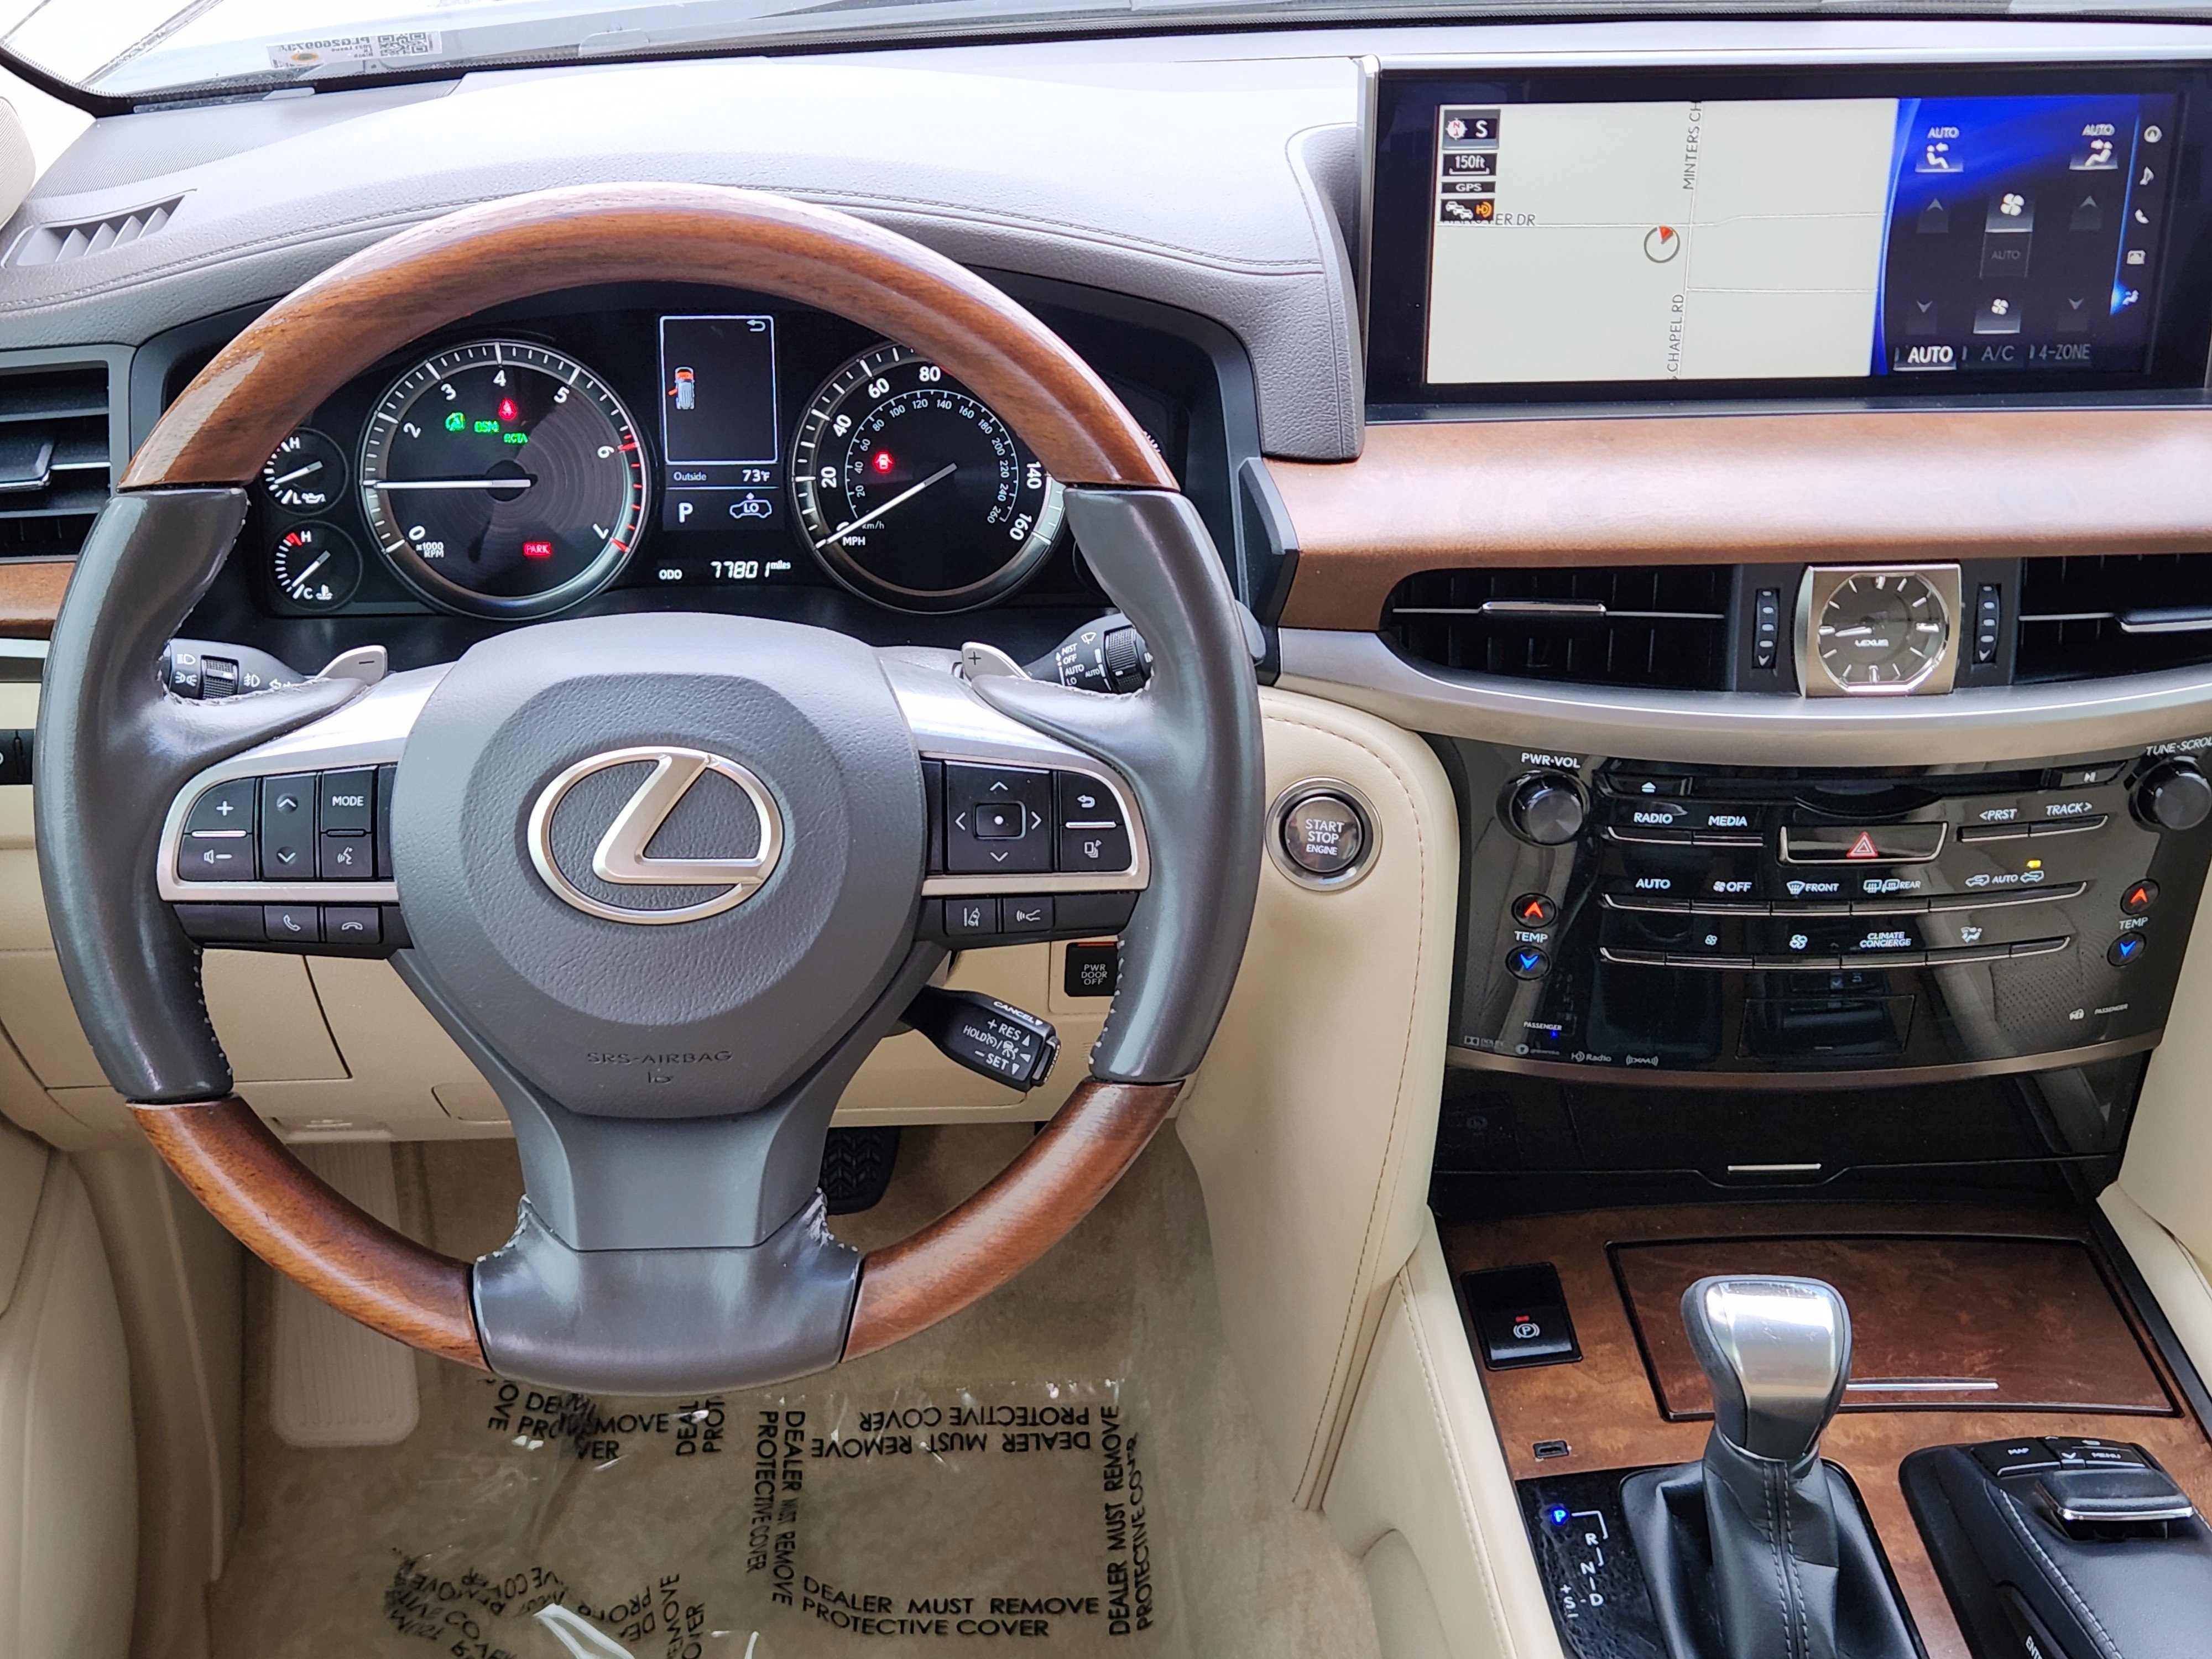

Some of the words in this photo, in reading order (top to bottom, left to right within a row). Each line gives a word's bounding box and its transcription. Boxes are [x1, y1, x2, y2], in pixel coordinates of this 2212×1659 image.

[1475, 119, 1488, 138] S
[1928, 126, 1959, 139] AUTO
[2081, 123, 2116, 137] AUTO
[1455, 155, 1485, 169] 150ft
[1683, 126, 1699, 190] MINTERS
[1455, 183, 1482, 192] GPS
[1516, 213, 1536, 226] DR
[1991, 249, 2021, 260] AUTO
[1672, 294, 1684, 312] RD
[1667, 317, 1682, 372] CHAPEL
[2039, 343, 2091, 360] 4-ZONE
[1907, 346, 1954, 364] AUTO
[1981, 346, 2016, 361] A/C
[493, 371, 507, 387] 4
[919, 365, 941, 382] 80
[441, 384, 457, 401] 3
[554, 386, 570, 404] 5
[868, 378, 890, 399] 60
[912, 398, 928, 409] 120
[935, 398, 953, 410] 140
[889, 404, 906, 419] 100
[957, 404, 976, 420] 160
[403, 422, 421, 438] 2
[833, 414, 852, 437] 40
[872, 419, 885, 432] 80
[977, 418, 994, 435] 180
[289, 437, 301, 449] H
[860, 439, 871, 452] 60
[991, 437, 1006, 457] 200
[597, 445, 615, 459] 6
[854, 461, 864, 474] 40
[1000, 459, 1010, 479] 220
[673, 472, 707, 482] Outside
[821, 466, 837, 489] 20
[857, 484, 866, 498] 20
[998, 482, 1010, 502] 240
[679, 502, 693, 523] P
[743, 502, 760, 514] LO
[987, 504, 1001, 525] 260
[408, 525, 426, 541] 0
[1009, 511, 1033, 541] 160
[301, 530, 312, 542] H
[842, 536, 866, 546] MPH
[424, 550, 444, 559] RPM
[525, 544, 549, 555] PARK
[659, 569, 683, 580] ODO
[710, 560, 770, 579] 77801
[303, 587, 314, 599] C
[1063, 655, 1077, 665] OFF
[1065, 664, 1084, 676] AUTO
[1085, 668, 1100, 678] AUTO
[1067, 676, 1077, 686] LO
[332, 796, 364, 807] MODE
[1306, 818, 1345, 833] START
[1634, 812, 1673, 825] RADIO
[1708, 815, 1747, 827] MEDIA
[1308, 832, 1339, 844] STOP
[1306, 844, 1338, 856] ENGINE
[1636, 878, 1671, 890] AUTO
[1726, 880, 1752, 893] OFF
[1900, 880, 1921, 889] REAR
[1992, 874, 2019, 884] AUTO
[1806, 883, 1839, 893] FRONT
[2119, 916, 2148, 930] TEMP
[1515, 931, 1548, 943] TEMP
[1867, 931, 1905, 940] CLIMATE
[1859, 938, 1912, 949] CONCIERGE
[993, 1001, 1035, 1024] CANCEL
[1524, 1021, 1563, 1031] PASSENGER
[587, 1050, 733, 1065] SRS-AIRBAG
[859, 1408, 942, 1432] COVER
[949, 1406, 1091, 1428] PROTECTIVE
[811, 1435, 914, 1459] REMOVE
[930, 1432, 988, 1454] MUST
[1002, 1431, 1091, 1454] DEALER
[1100, 1406, 1126, 1492] REMOVE
[781, 1411, 806, 1492] DEALER
[751, 1411, 779, 1524] PROTECTIVE
[1554, 1510, 1567, 1522] P
[1105, 1503, 1127, 1552] MUST
[1585, 1533, 1598, 1546] R
[772, 1530, 796, 1606] REMOVE
[1131, 1507, 1154, 1631] PROTECTIVE
[1580, 1562, 1597, 1575] N
[803, 1575, 893, 1614] DEALER
[907, 1598, 974, 1615] MUST
[990, 1597, 1100, 1615] REMOVE
[1107, 1559, 1131, 1636] DEALER
[1563, 1597, 1575, 1609] S
[1589, 1593, 1604, 1607] D
[802, 1597, 949, 1635] PROTECTIVE
[956, 1619, 1050, 1636] COVER
